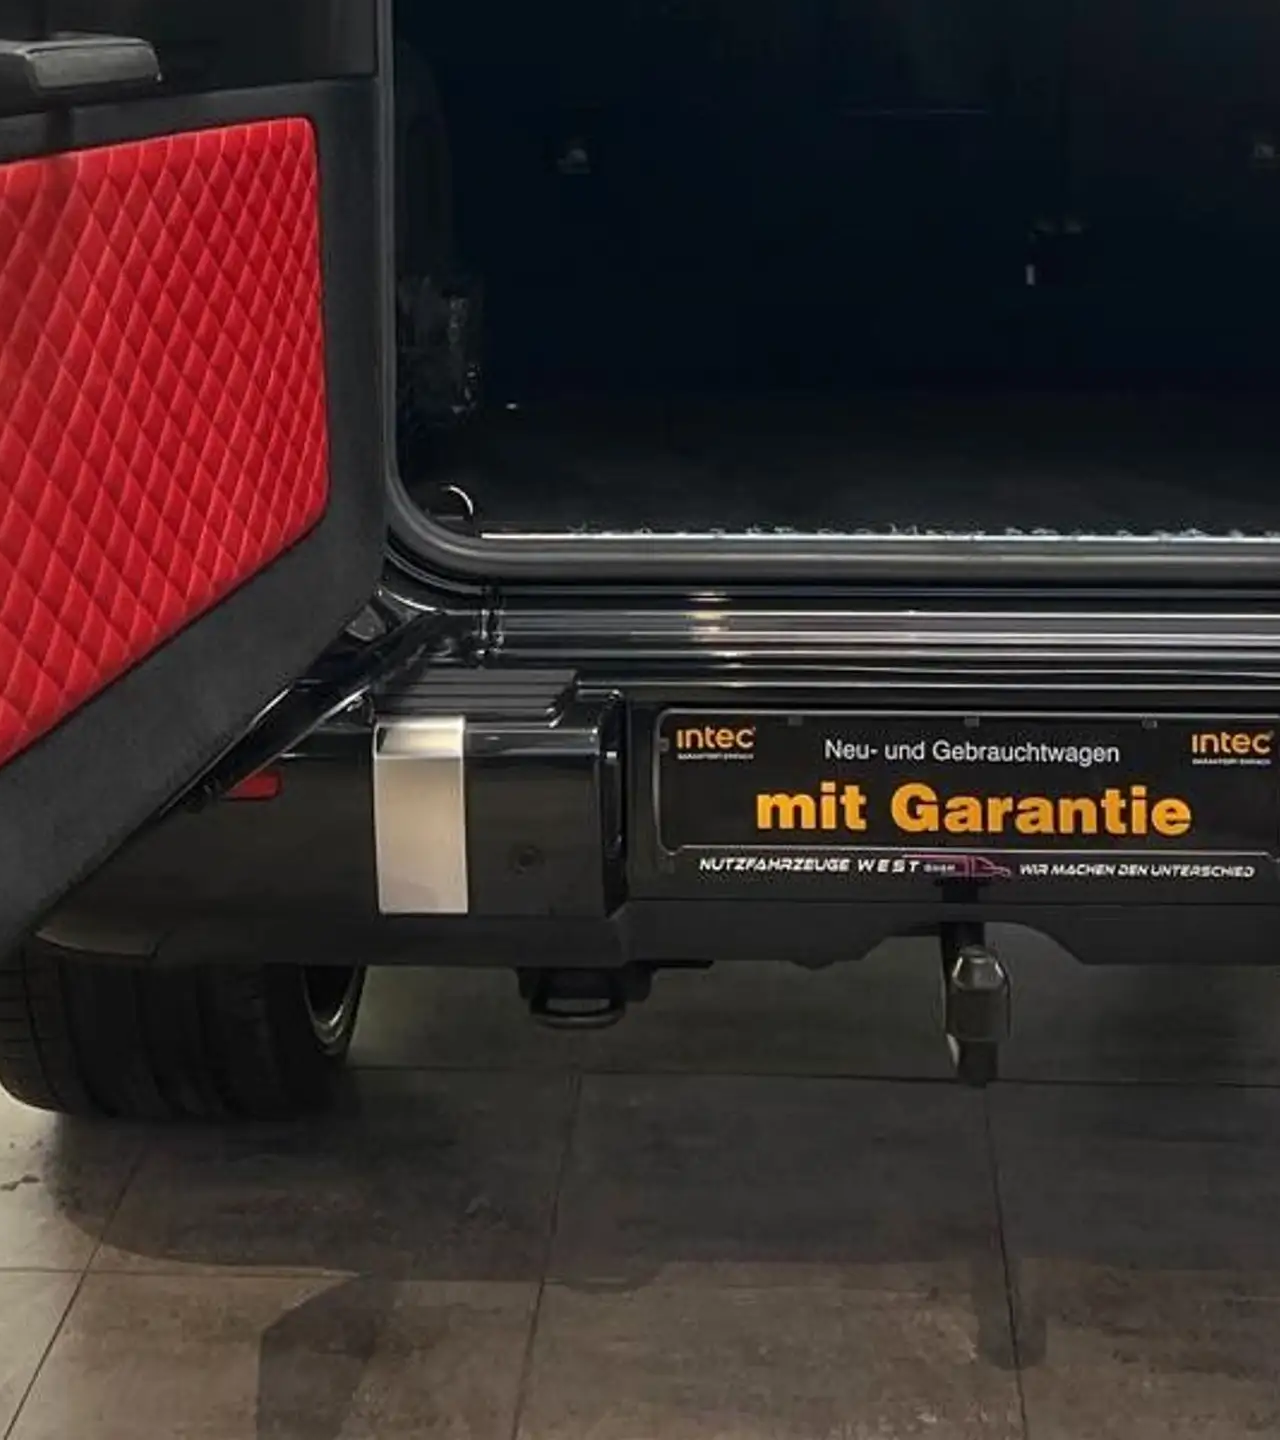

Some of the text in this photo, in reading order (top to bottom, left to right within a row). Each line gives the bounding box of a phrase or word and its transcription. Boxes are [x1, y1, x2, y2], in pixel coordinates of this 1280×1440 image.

[676, 726, 756, 750] intec
[1191, 731, 1272, 756] intec
[824, 739, 1120, 768] Neu- und Gebrauchtwagen
[756, 781, 1193, 836] mit Garantie
[699, 857, 851, 873] NUTZFAHRZEUGE
[1020, 863, 1049, 876] WIR
[1051, 863, 1116, 877] MACHEN
[1151, 863, 1256, 879] UNTERSCHIED
